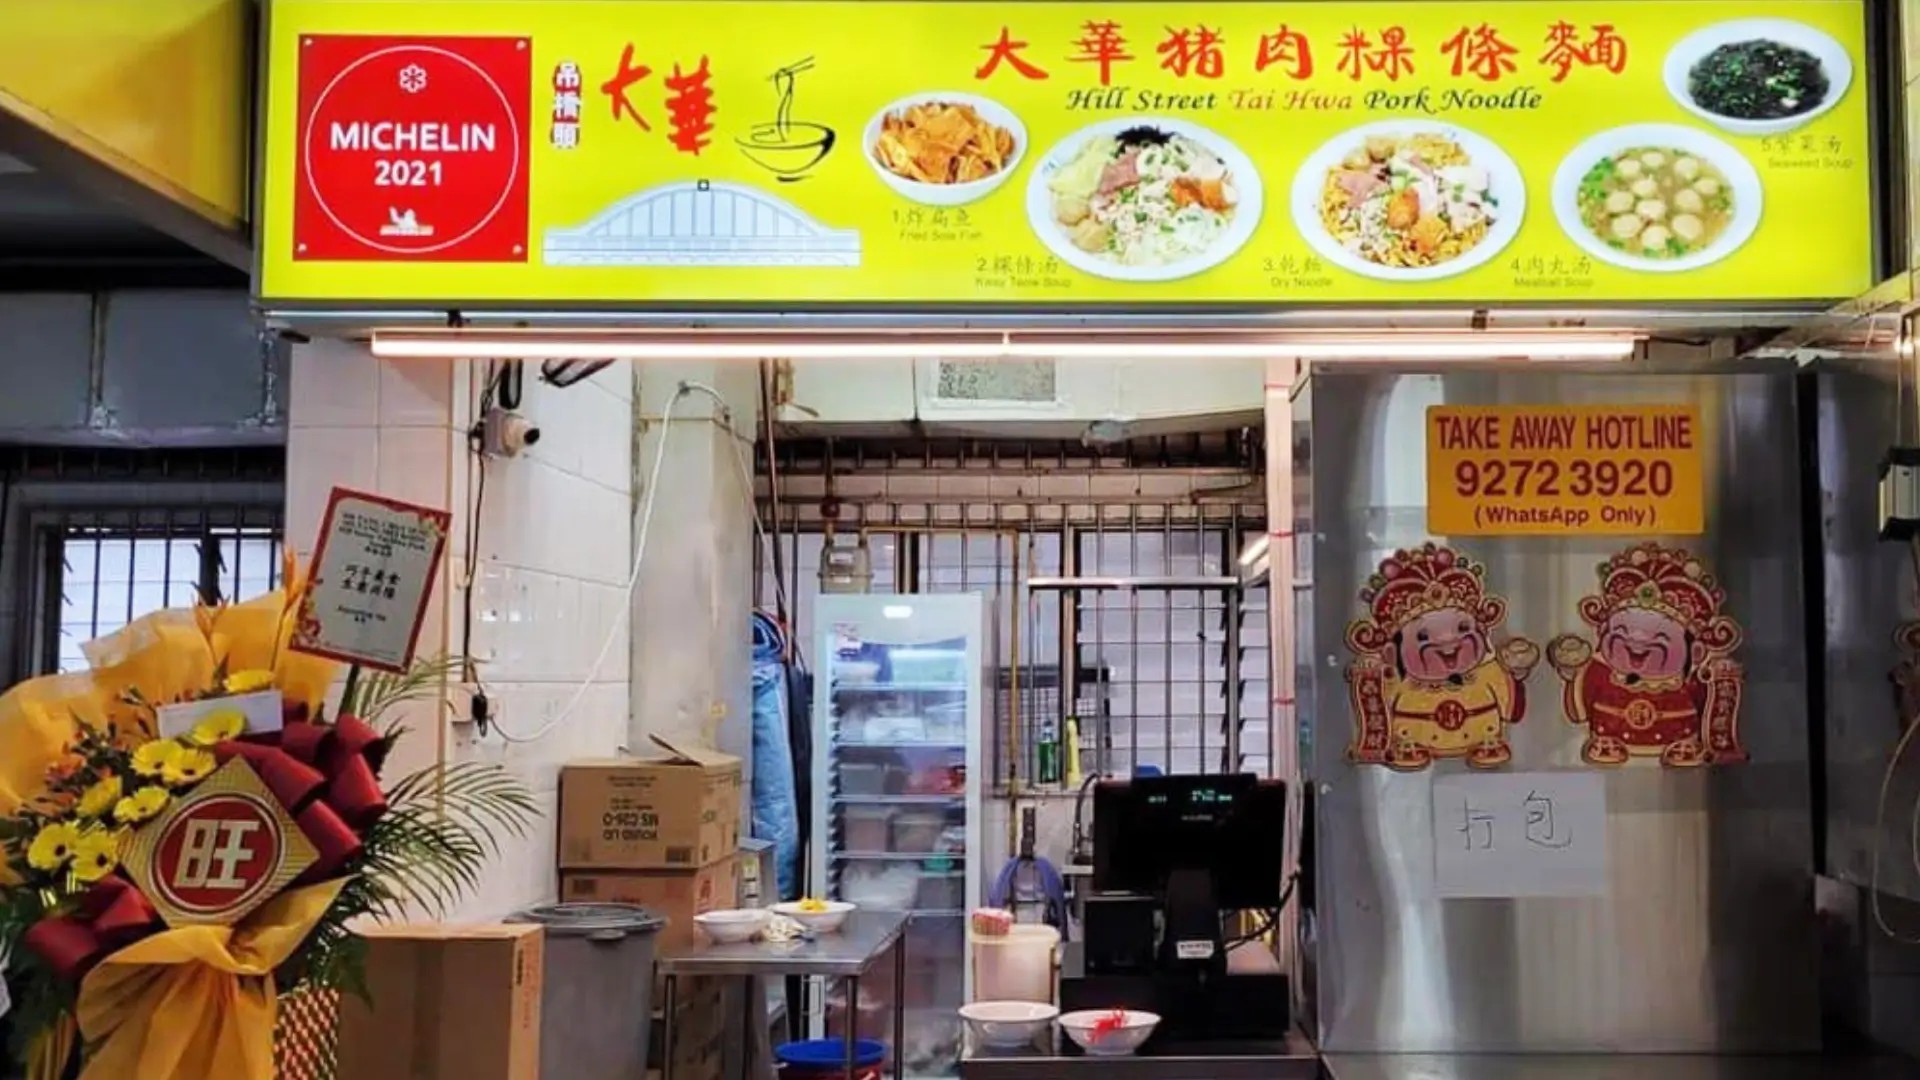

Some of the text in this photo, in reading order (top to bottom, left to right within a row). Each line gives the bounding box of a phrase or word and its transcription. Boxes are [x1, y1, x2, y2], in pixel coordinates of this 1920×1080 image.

[1066, 86, 1542, 114] Hill Street Tai Hwa Pork Noodle
[330, 121, 495, 151] MICHELIN
[374, 159, 442, 186] 2021
[1436, 416, 1692, 449] TAKE AWAY HOTLINE
[1455, 459, 1673, 497] 9272 3920
[1456, 789, 1573, 852] 打包
[173, 818, 261, 889] 旺
